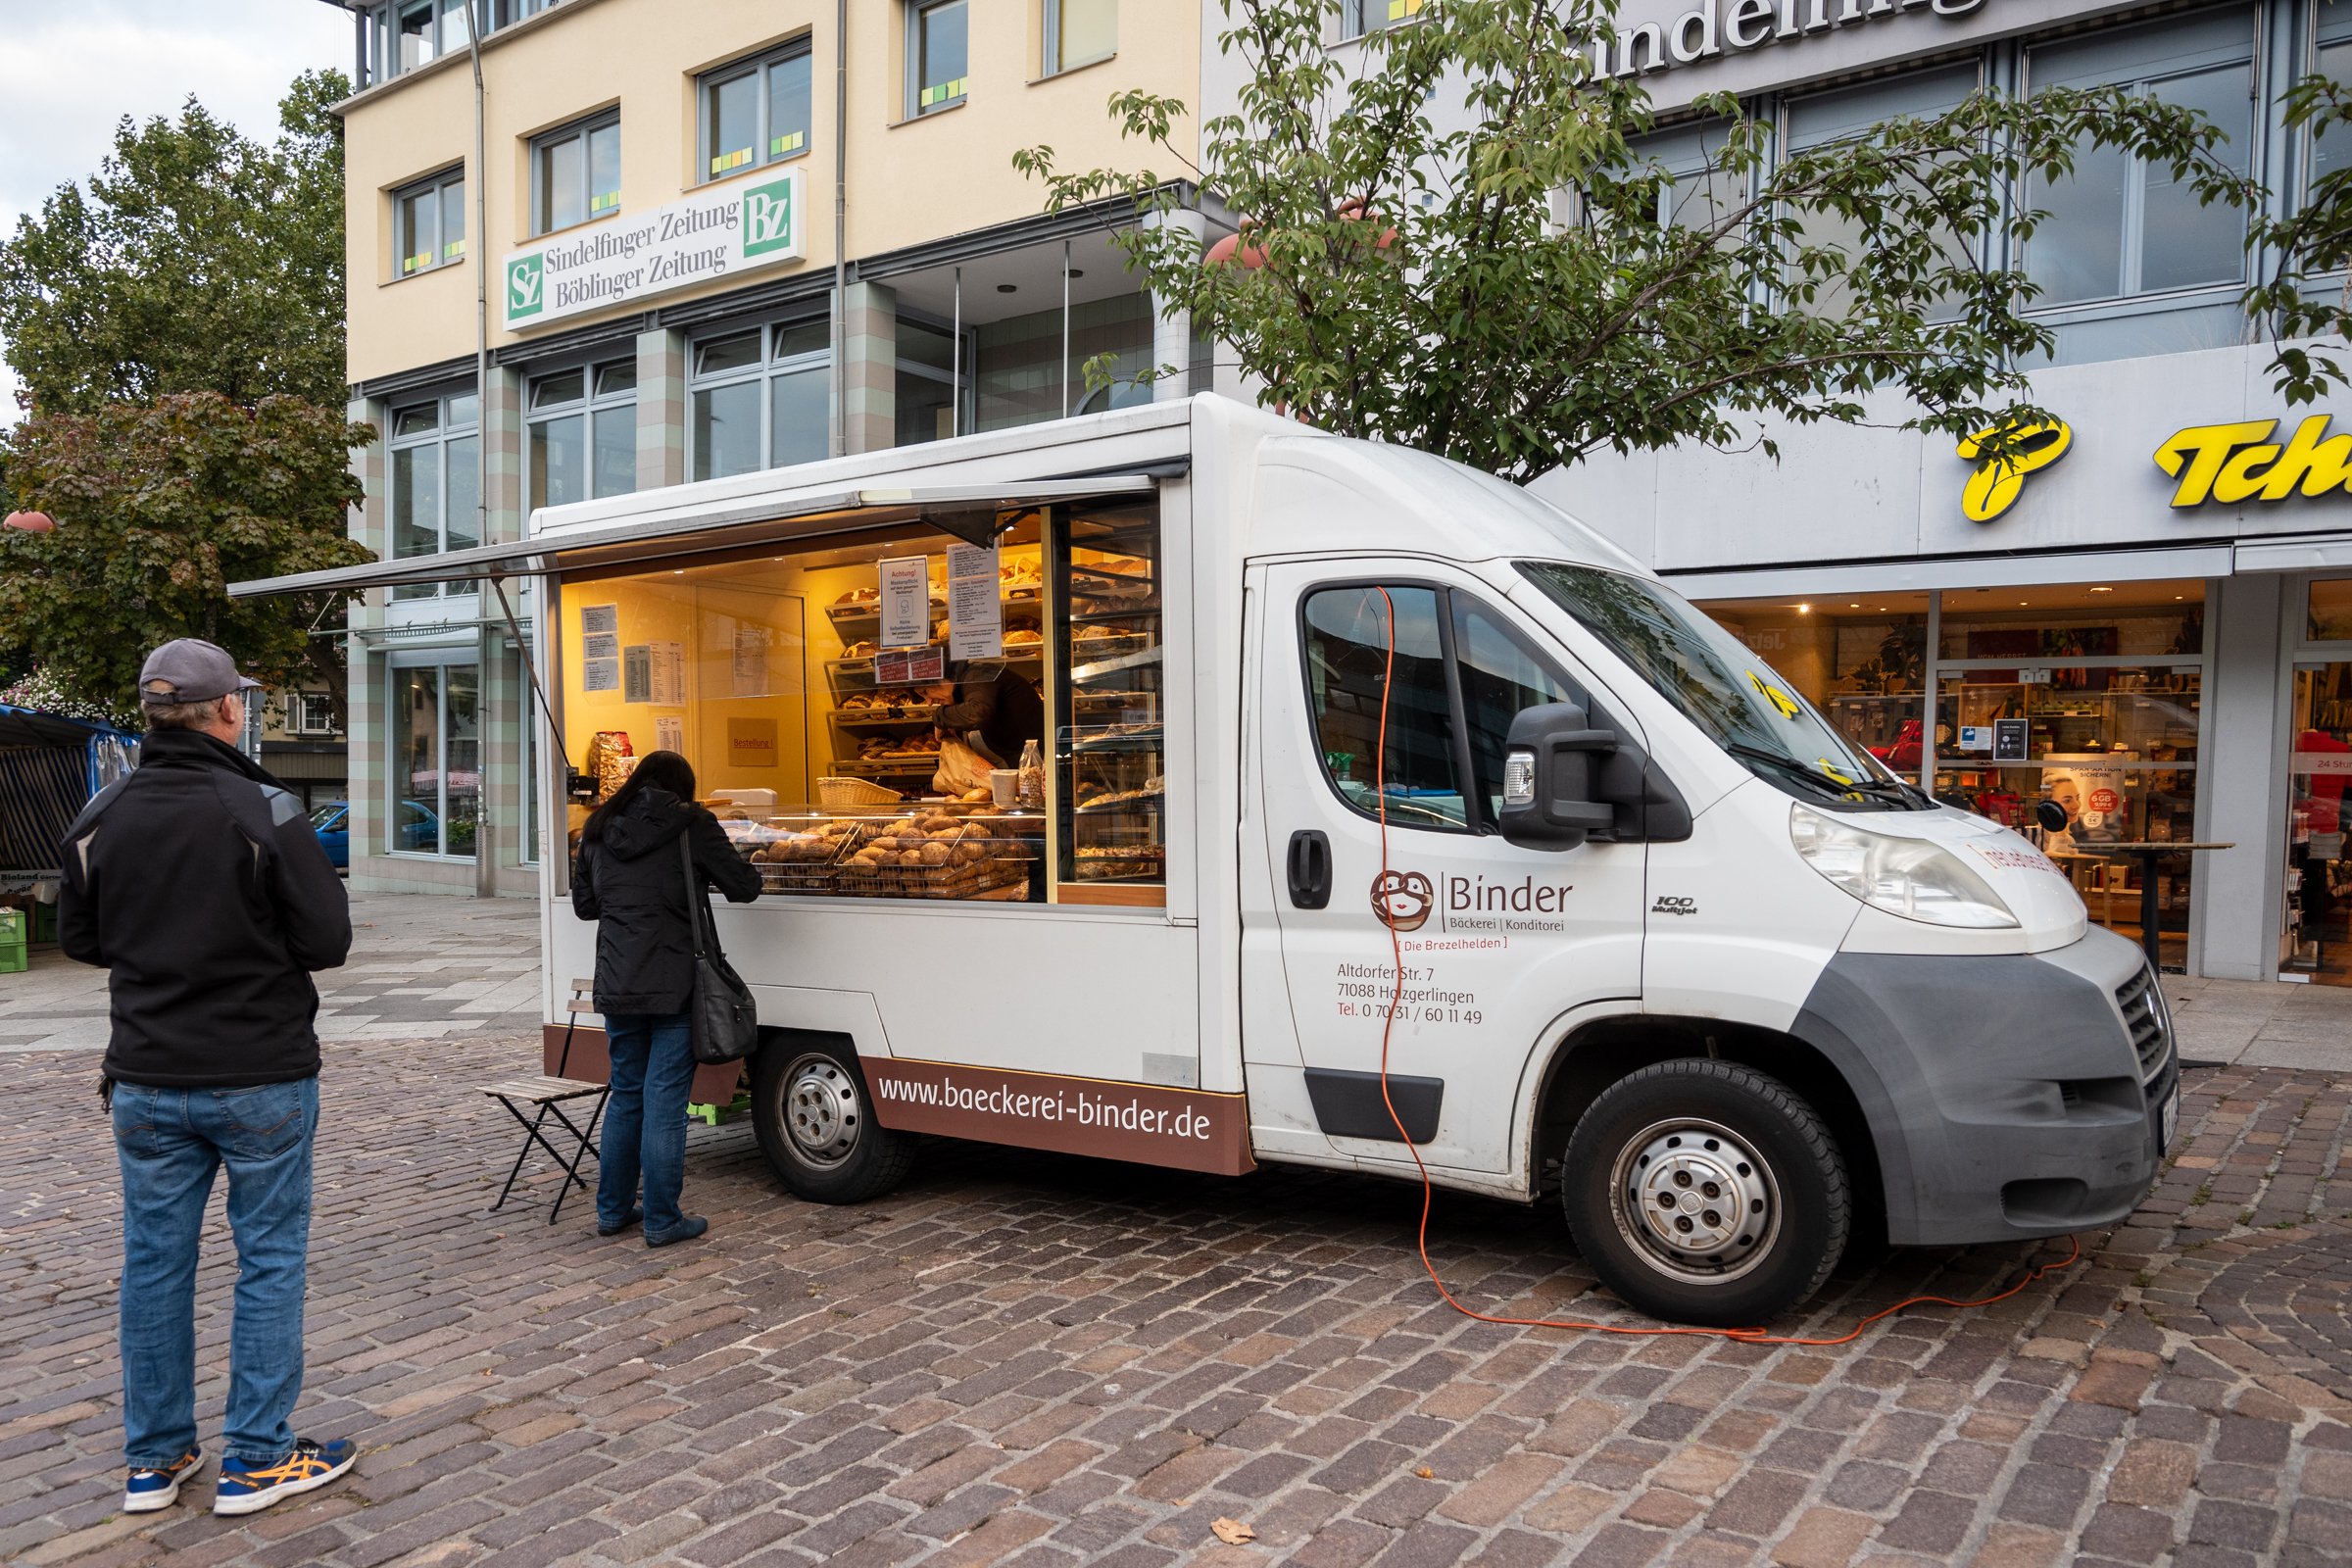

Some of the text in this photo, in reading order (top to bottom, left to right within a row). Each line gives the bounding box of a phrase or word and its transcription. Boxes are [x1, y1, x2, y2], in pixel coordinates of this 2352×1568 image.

[545, 201, 740, 274] Sindelfinger Zeitung
[555, 244, 727, 309] Böblinger Zeitung
[2153, 414, 2352, 509] Tch
[733, 738, 769, 748] Bestellung
[1450, 875, 1574, 912] Binder
[1656, 896, 1693, 906] 100
[1450, 917, 1564, 931] Bäckerei Konditorei
[1404, 941, 1422, 952] Die
[1425, 938, 1500, 951] Brezelhelden
[1338, 963, 1434, 981] Altdorfer Str. 7
[1338, 983, 1474, 1005] 71088 Holzgerlingen
[1338, 1003, 1358, 1016] Tel.
[1362, 1004, 1371, 1017] 0
[1375, 1004, 1391, 1018] 70
[1396, 1005, 1408, 1019] 31
[1425, 1008, 1443, 1022] 60
[1448, 1009, 1458, 1023] 11
[1463, 1010, 1482, 1024] 49
[878, 1077, 1210, 1140] www.baeckerei-binder.de
